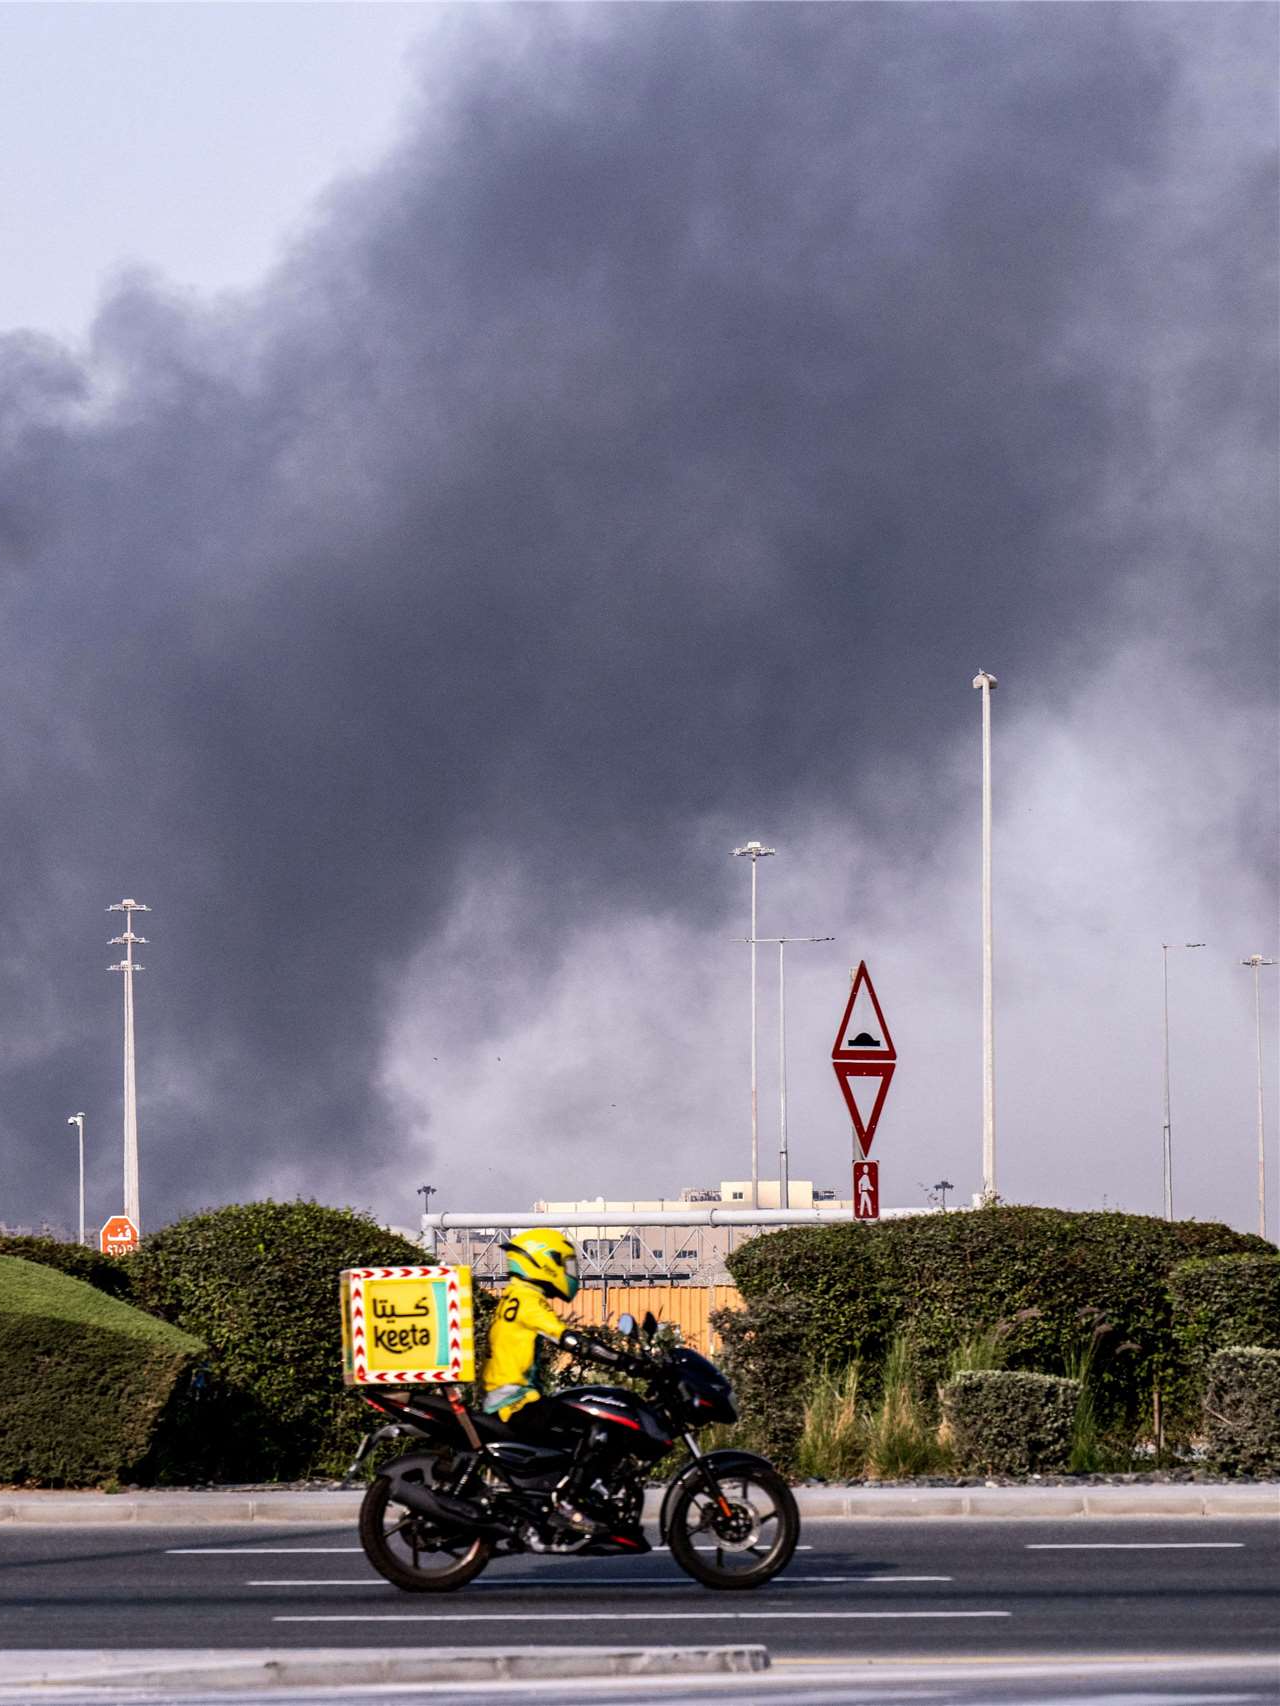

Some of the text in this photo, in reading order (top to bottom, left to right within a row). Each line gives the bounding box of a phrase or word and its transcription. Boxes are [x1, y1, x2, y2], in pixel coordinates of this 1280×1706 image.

[107, 1225, 132, 1242] قف
[372, 1297, 429, 1324] كيتا
[374, 1324, 430, 1355] keeta
